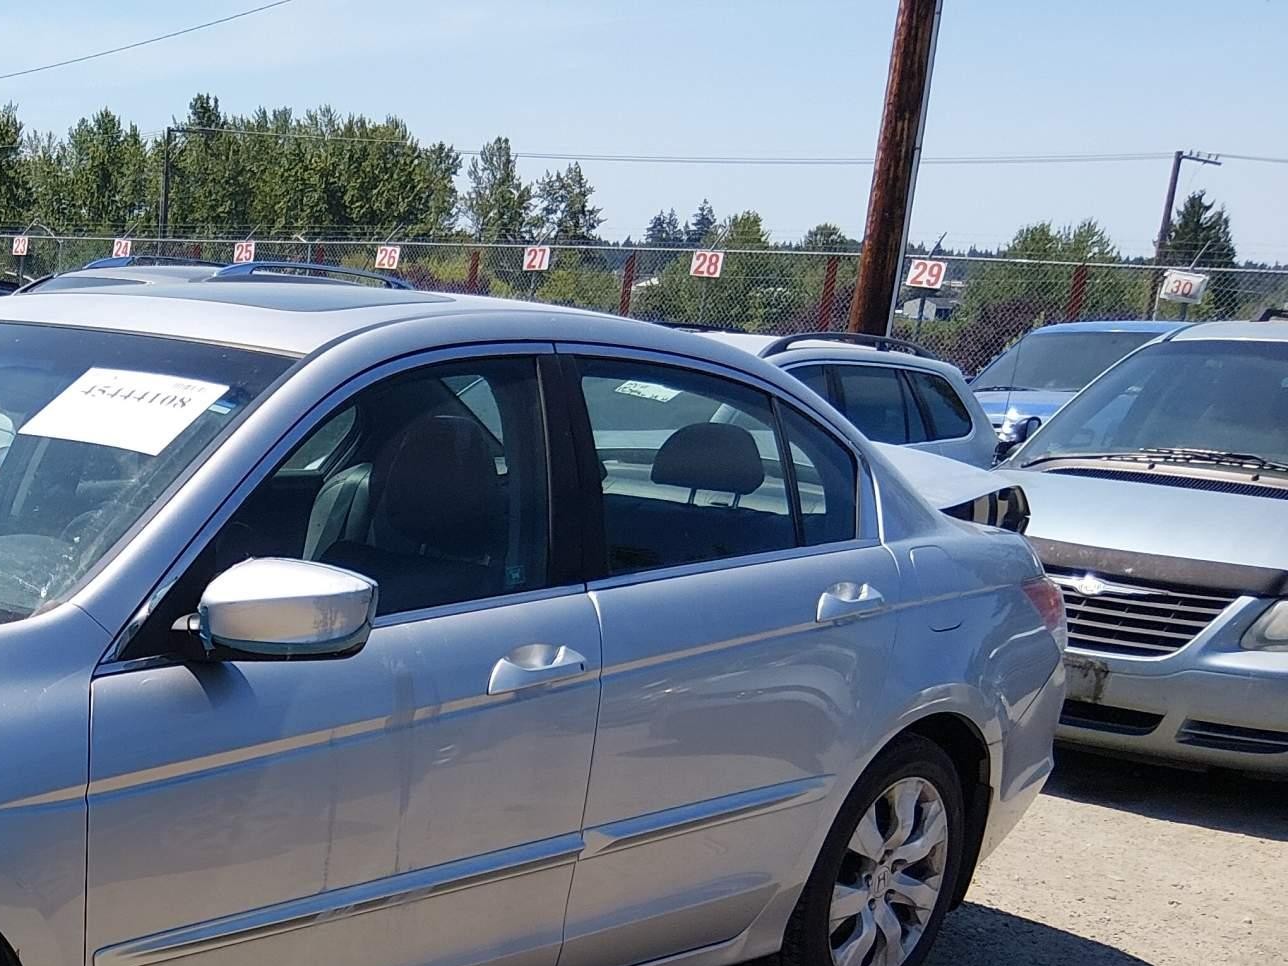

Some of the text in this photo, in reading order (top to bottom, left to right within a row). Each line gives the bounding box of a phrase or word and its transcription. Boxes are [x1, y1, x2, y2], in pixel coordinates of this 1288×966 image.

[14, 239, 26, 254] 23
[114, 240, 129, 257] 24
[235, 244, 253, 262] 25
[377, 248, 397, 267] 26
[526, 249, 546, 269] 27
[693, 252, 720, 276] 28
[910, 261, 943, 287] 29
[1171, 279, 1193, 296] 30
[81, 385, 192, 408] 45444108
